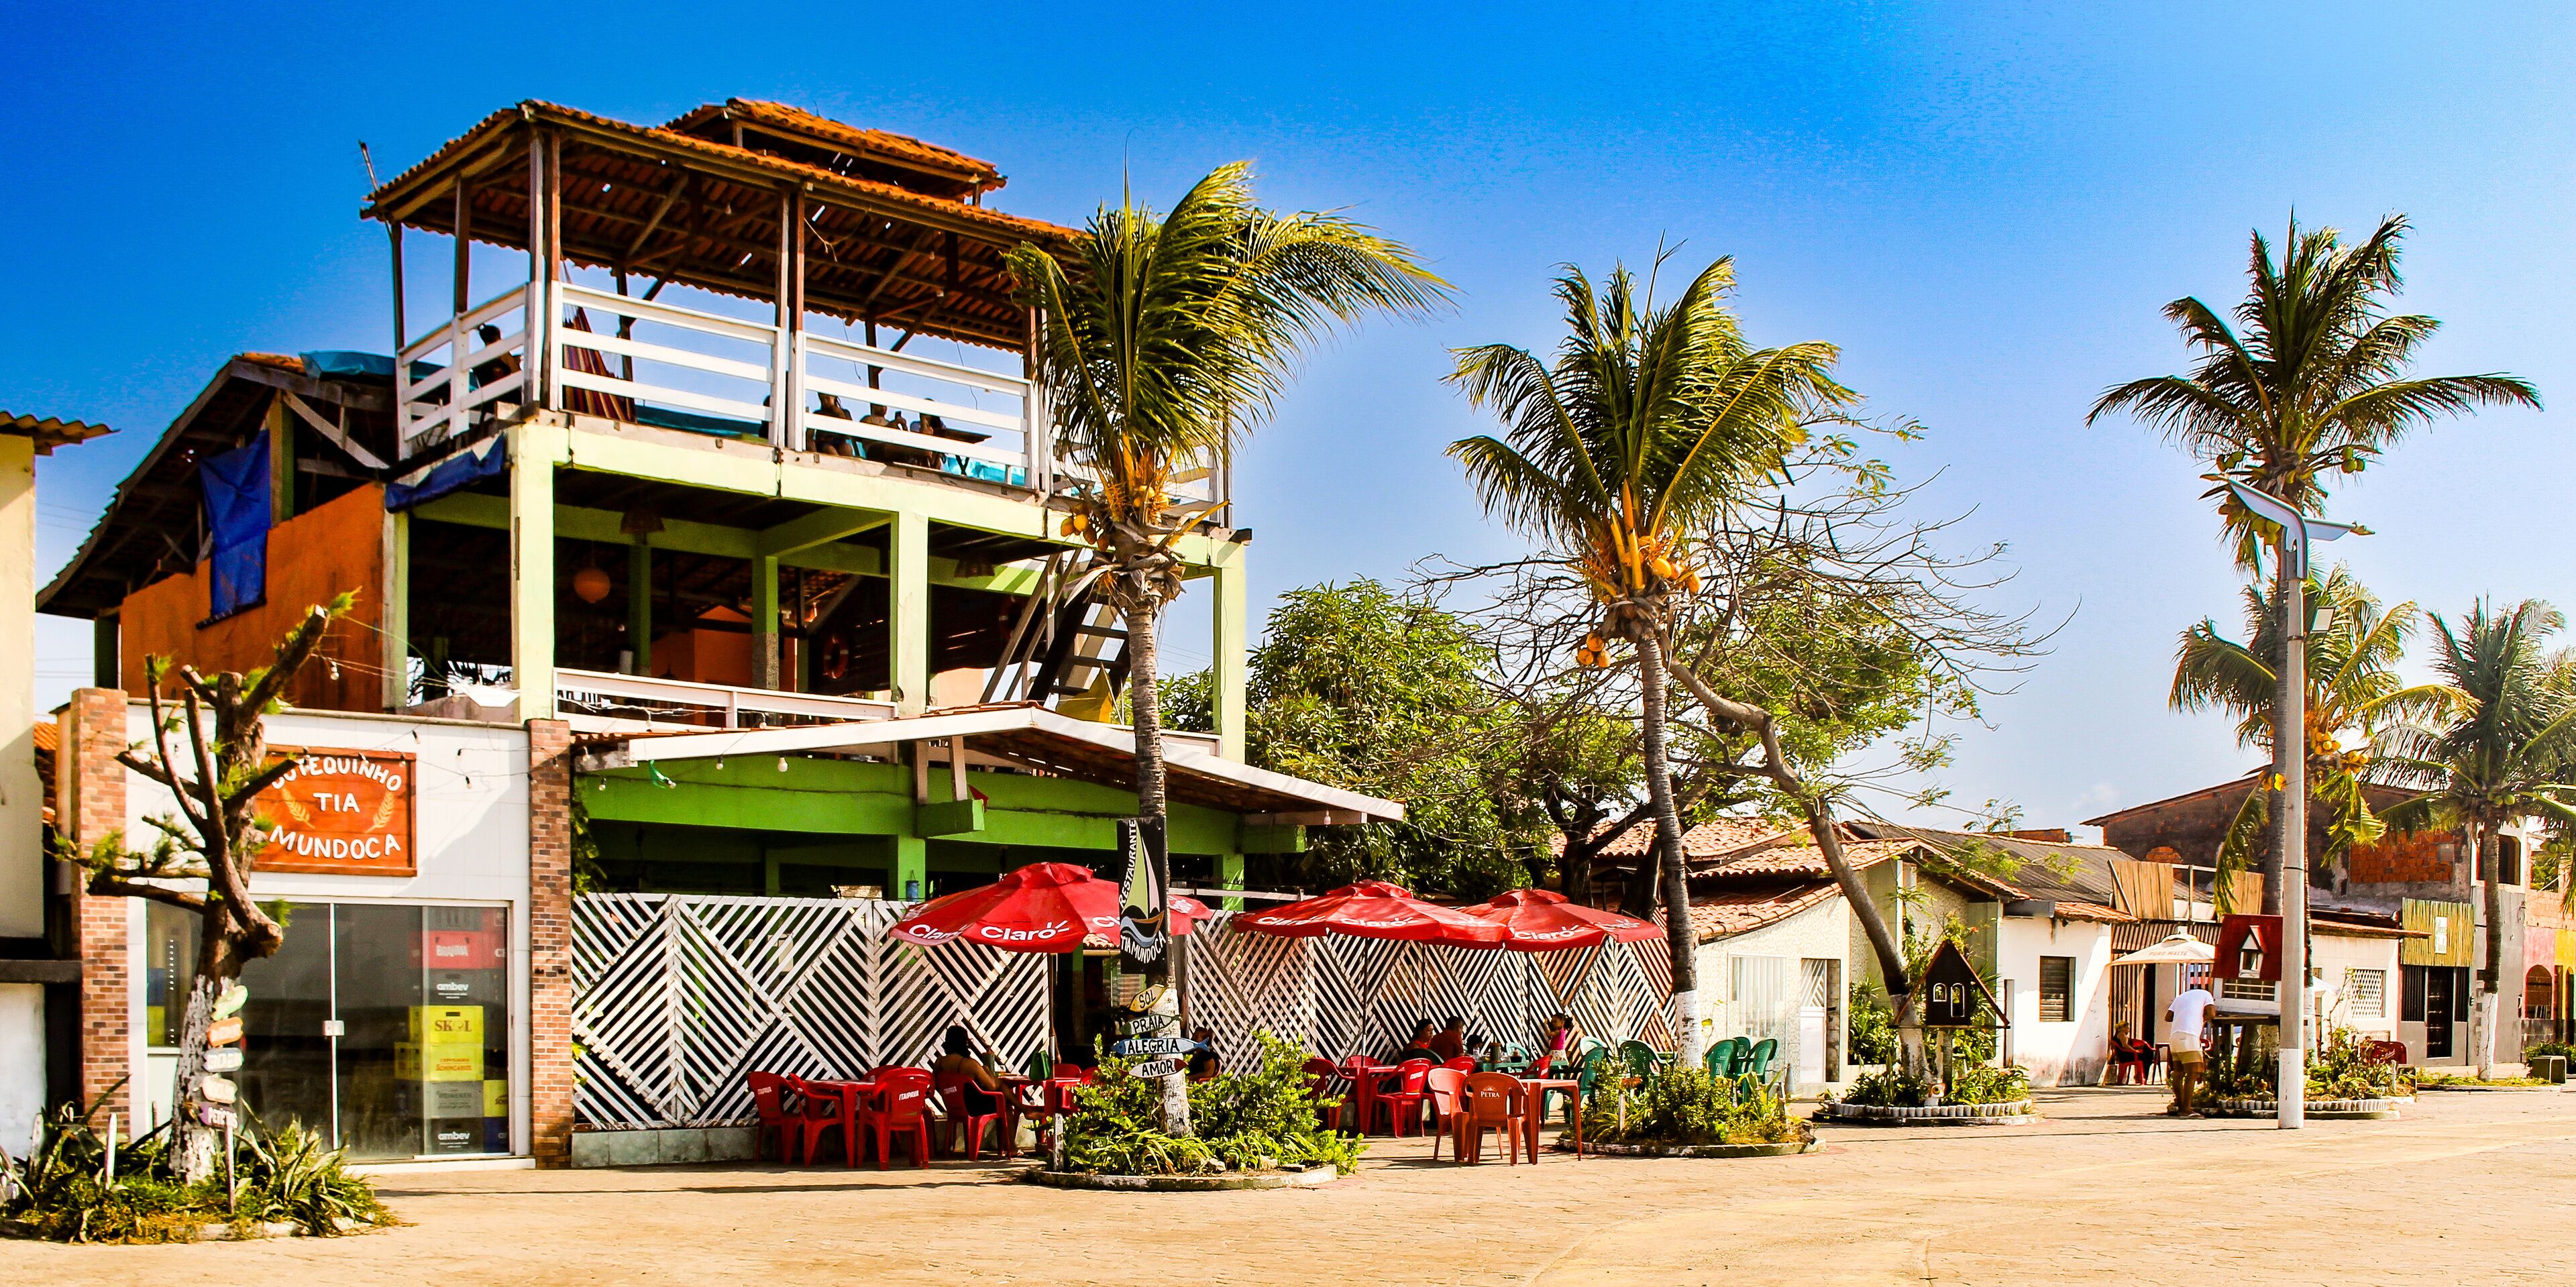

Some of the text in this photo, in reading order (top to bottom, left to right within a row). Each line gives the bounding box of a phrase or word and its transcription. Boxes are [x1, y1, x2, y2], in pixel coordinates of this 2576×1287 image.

[313, 792, 360, 813] TIA
[269, 824, 401, 860] MUNDOCA
[1119, 819, 1137, 909] RESTAURANTE
[1340, 917, 1407, 928] Claro
[980, 924, 1057, 941] Claro
[1514, 928, 1575, 940] Claro
[437, 982, 469, 991] ambev
[1138, 989, 1157, 1009] SOL
[1132, 1015, 1165, 1033] PRAIA
[1127, 1038, 1181, 1054] ALEGRIA
[1142, 1062, 1175, 1077] AMOR
[899, 1090, 919, 1101] ITAIPAVA
[437, 1131, 470, 1141] ambev
